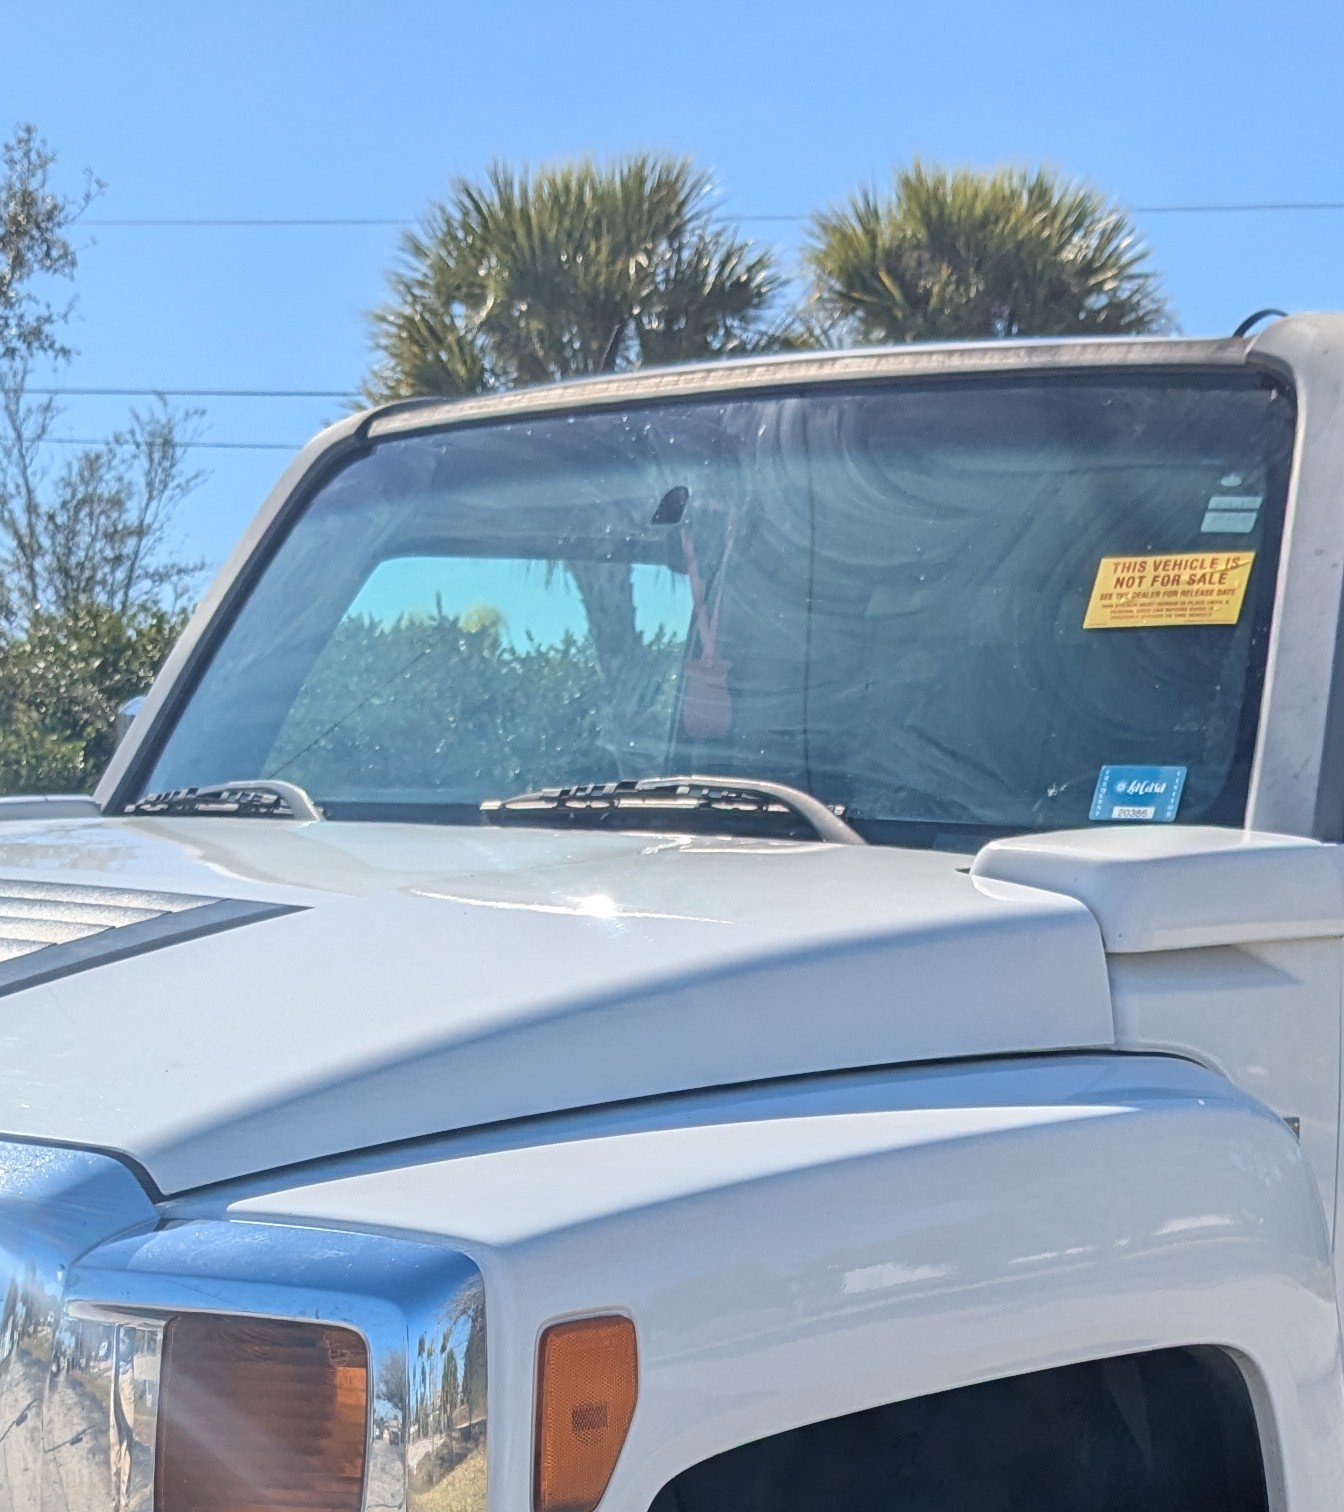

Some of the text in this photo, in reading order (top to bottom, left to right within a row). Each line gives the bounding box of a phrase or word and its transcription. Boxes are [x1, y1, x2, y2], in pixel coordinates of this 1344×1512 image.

[1112, 556, 1241, 574] THIS VEHICLE IS
[1113, 572, 1228, 589] NOT FOR SALE
